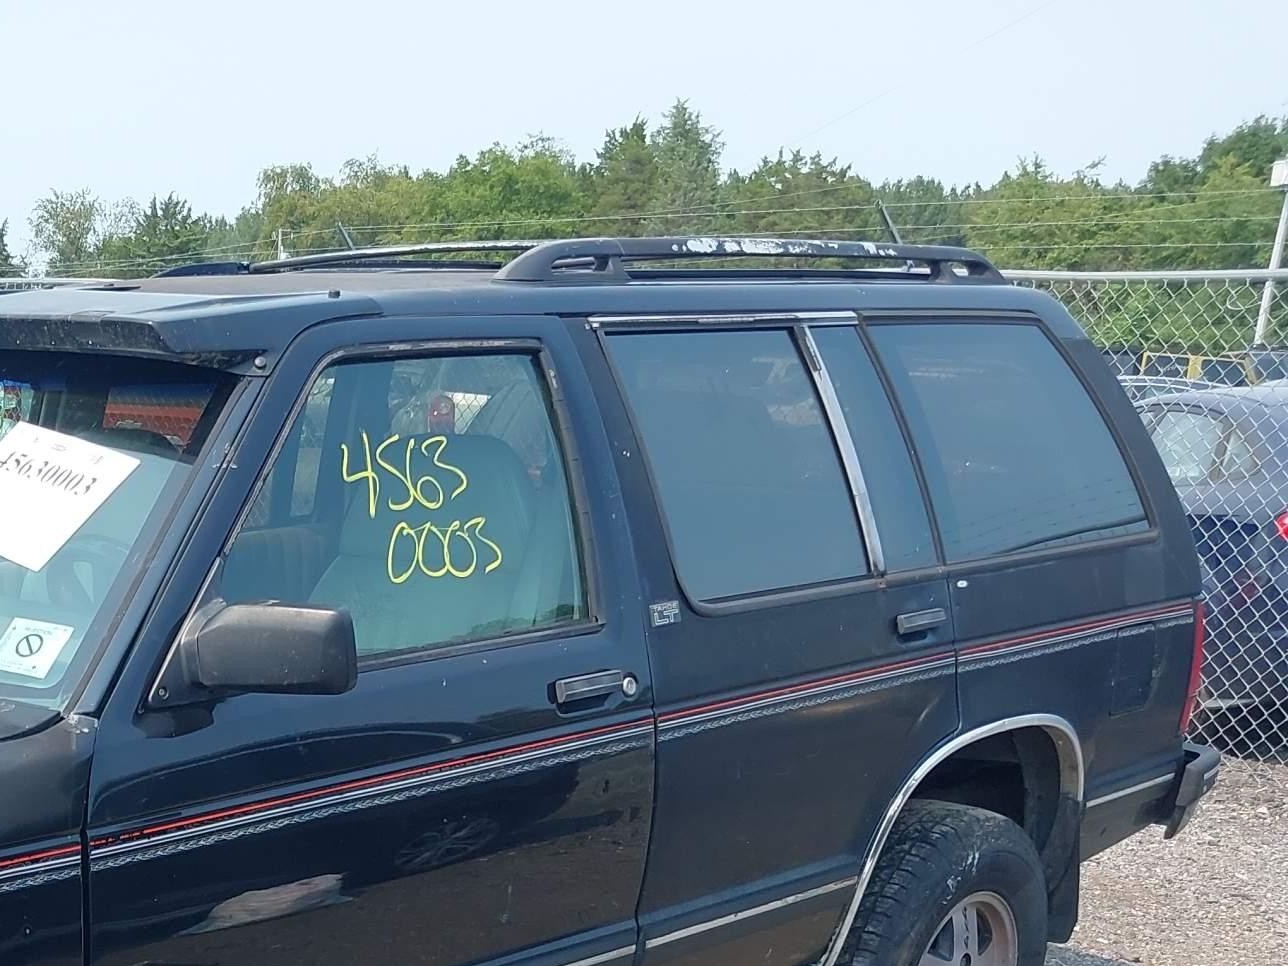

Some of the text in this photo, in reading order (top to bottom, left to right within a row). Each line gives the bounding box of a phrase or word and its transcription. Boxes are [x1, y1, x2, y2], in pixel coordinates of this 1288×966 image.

[341, 430, 468, 518] 4563
[387, 516, 503, 584] 0003
[654, 609, 679, 626] LT
